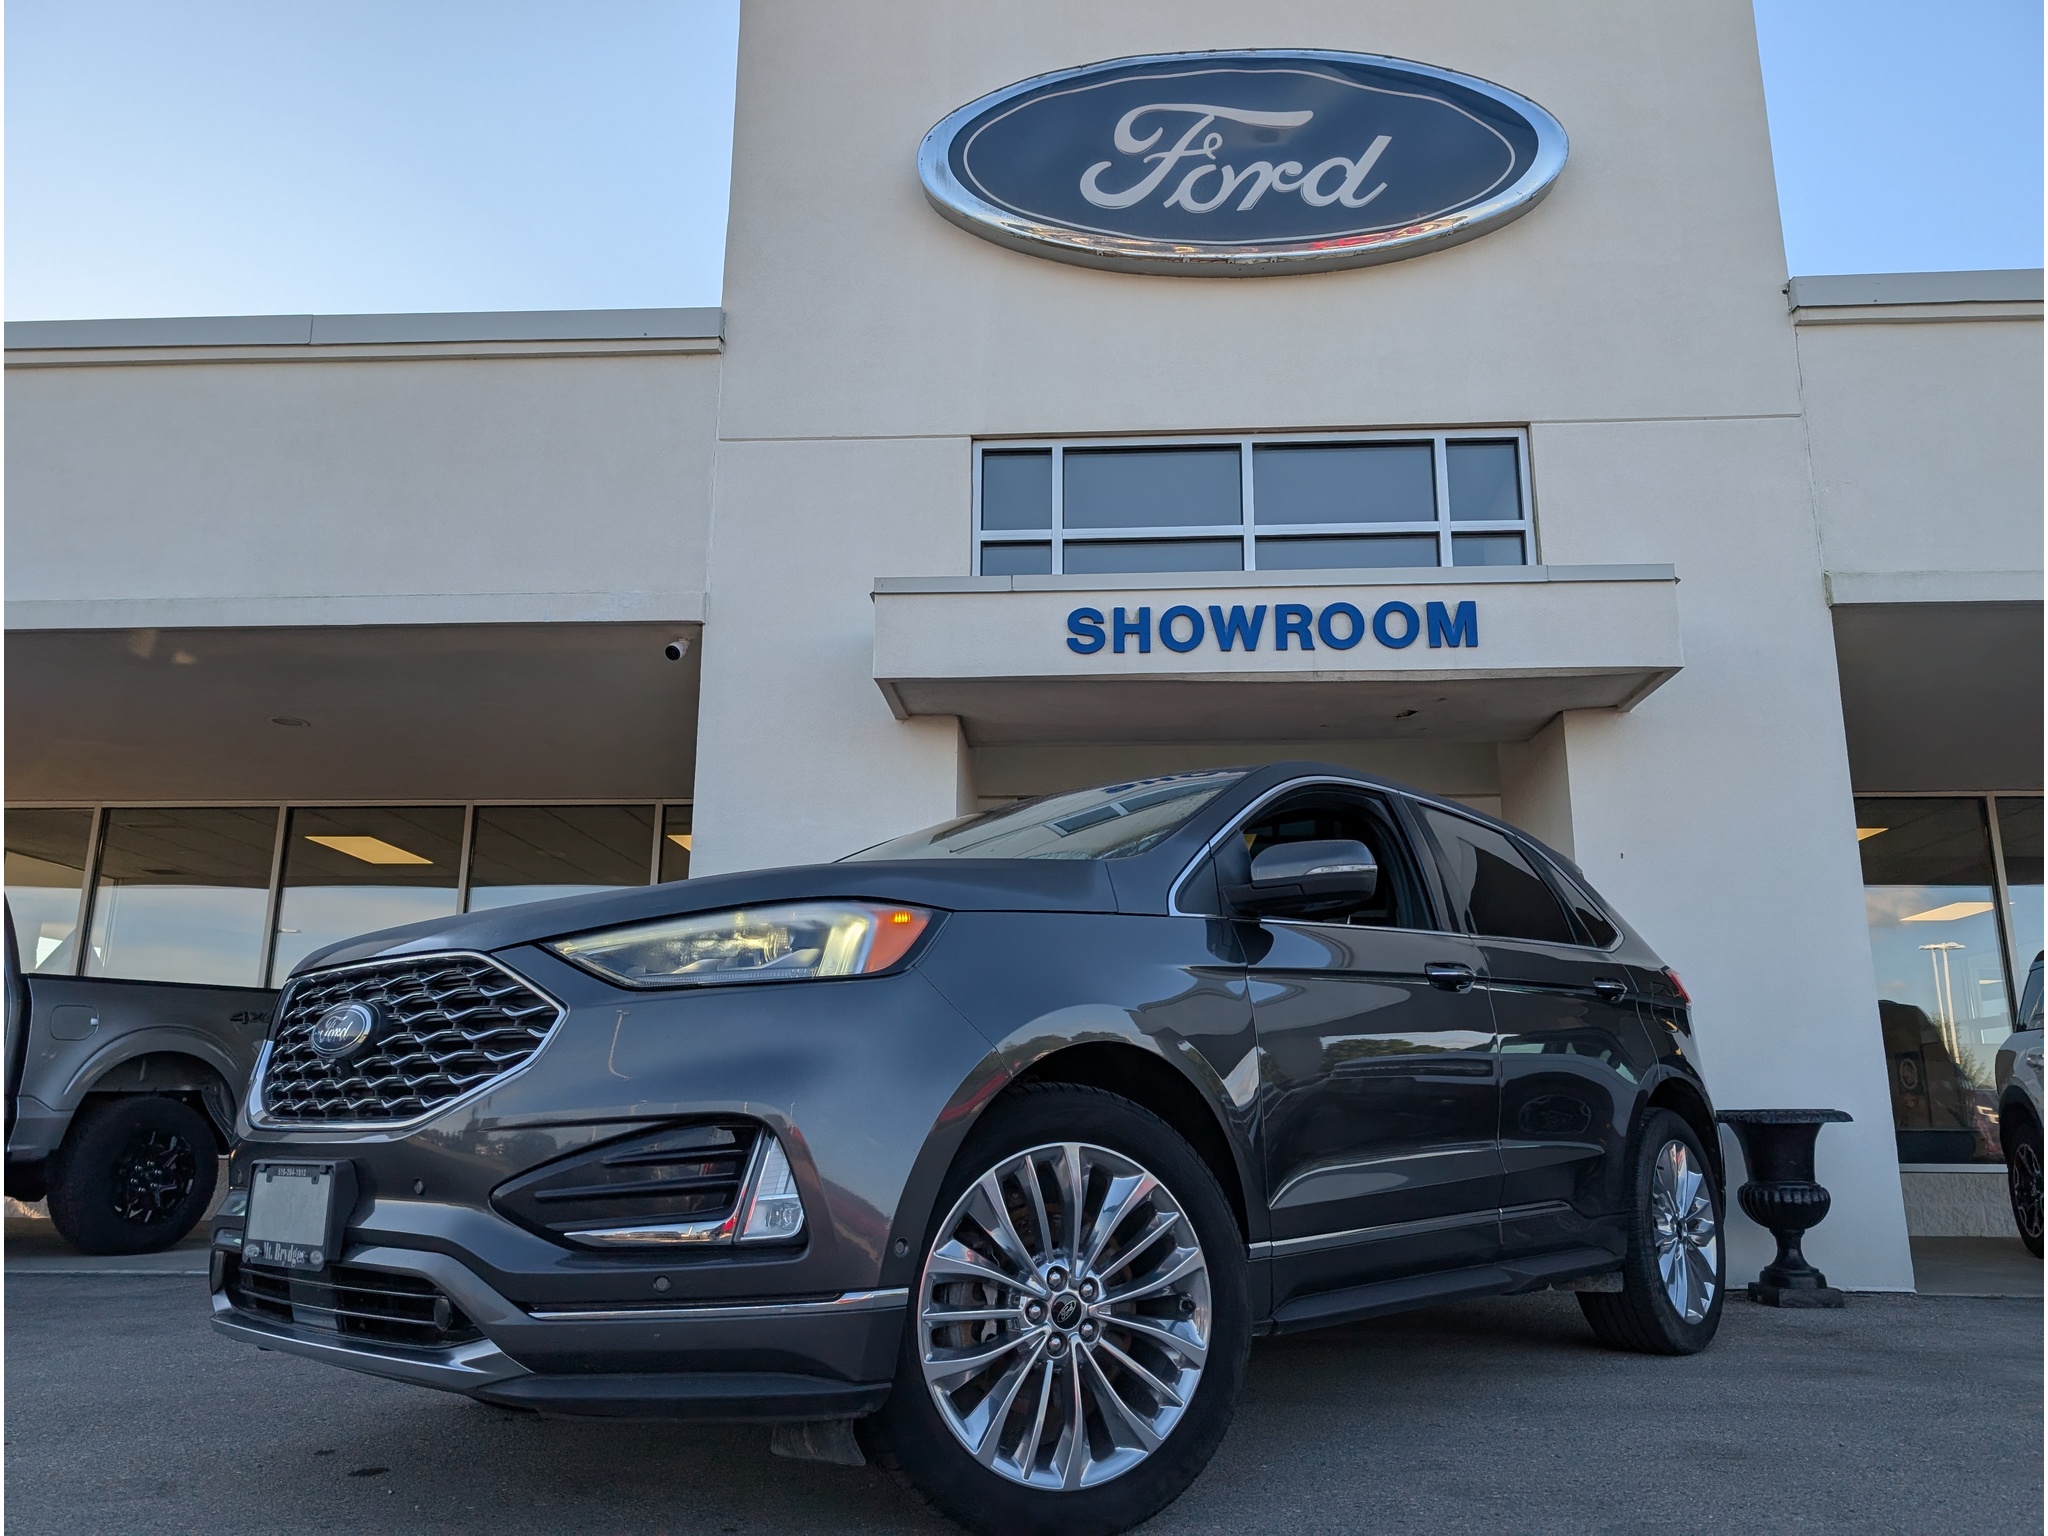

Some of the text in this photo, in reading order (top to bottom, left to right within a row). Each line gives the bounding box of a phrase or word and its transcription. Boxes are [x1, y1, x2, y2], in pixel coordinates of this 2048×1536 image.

[1080, 104, 1393, 213] Ford
[1066, 601, 1479, 655] SHOWROOM
[318, 1015, 353, 1043] Ford
[274, 1242, 306, 1268] Brydges
